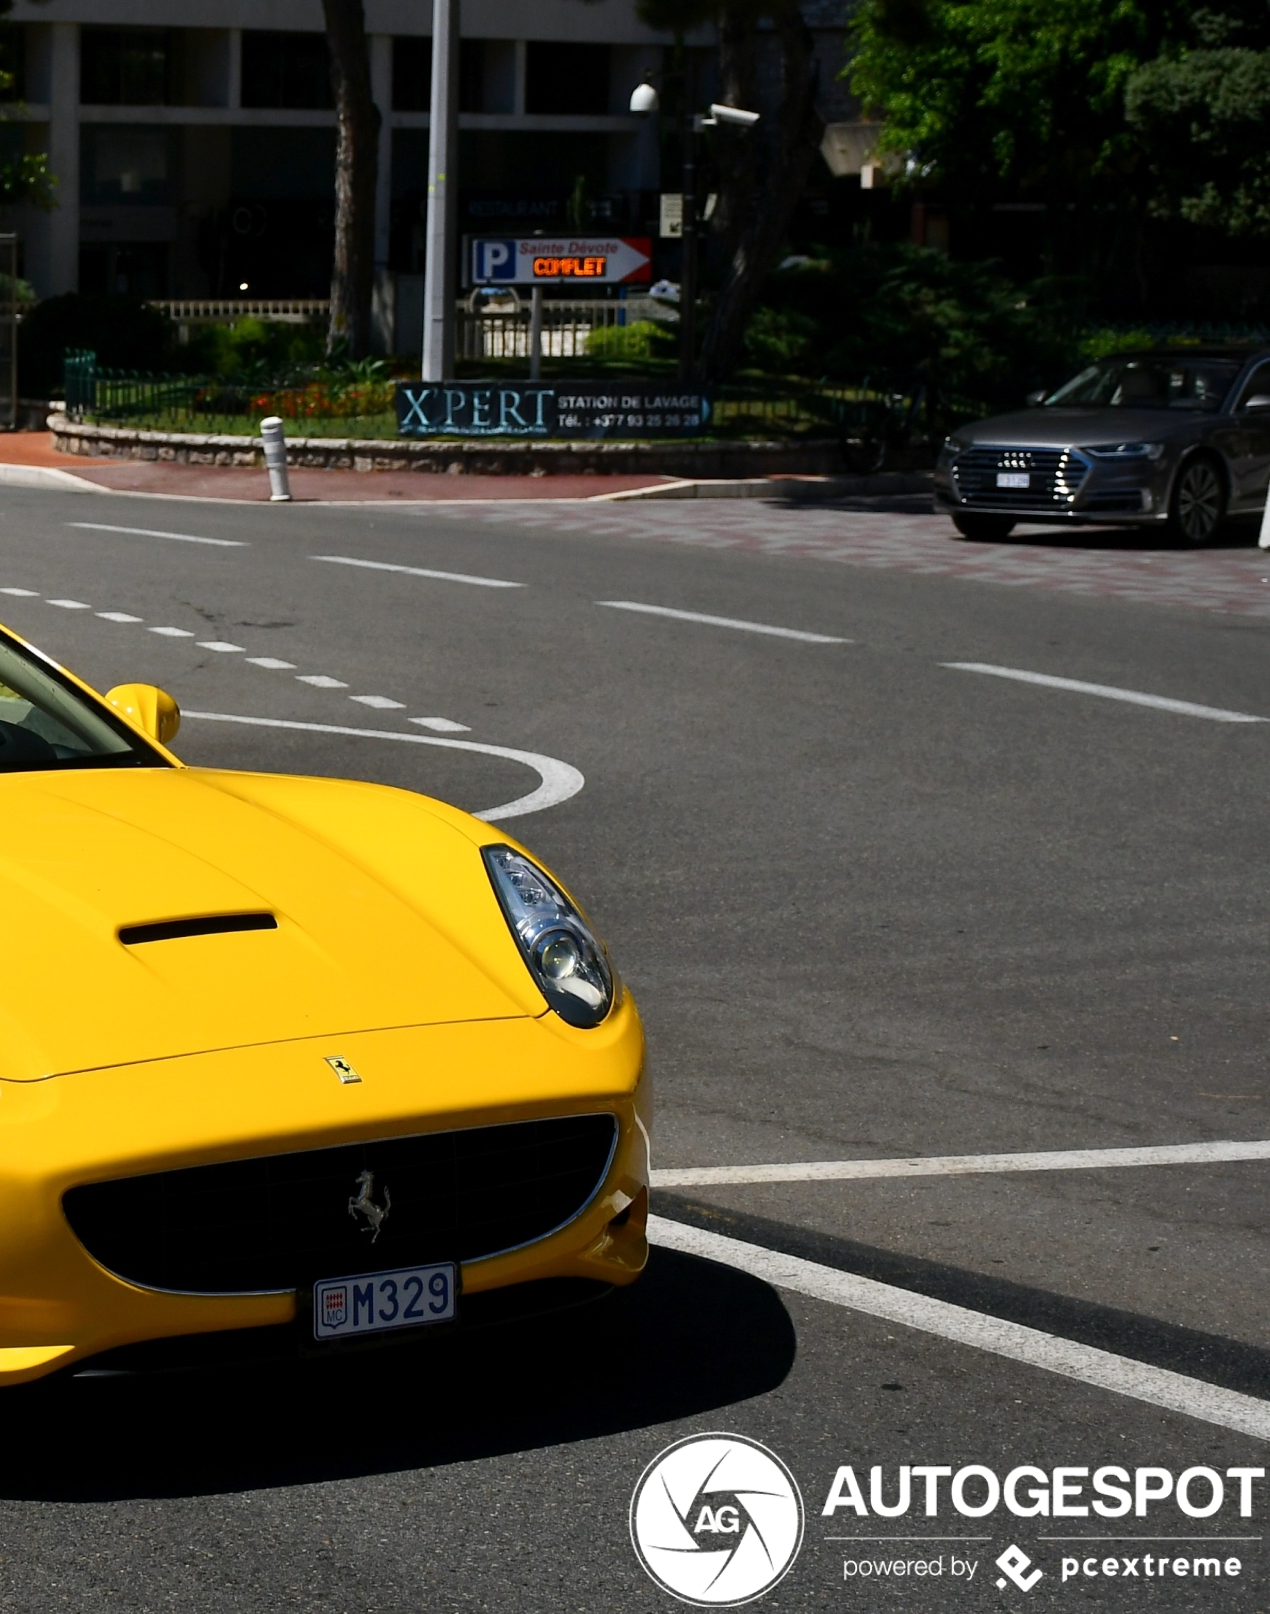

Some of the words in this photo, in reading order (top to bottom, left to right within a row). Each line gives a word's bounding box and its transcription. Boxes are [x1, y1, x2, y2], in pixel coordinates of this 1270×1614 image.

[520, 242, 564, 255] Sainte
[568, 241, 618, 255] Dévote
[484, 243, 510, 277] P
[534, 257, 606, 276] COMPLET
[558, 396, 617, 409] STATION
[621, 396, 640, 409] DE
[644, 396, 699, 409] LAVAGE
[593, 413, 624, 427] +377
[353, 1272, 448, 1327] M329
[326, 1309, 343, 1323] MC
